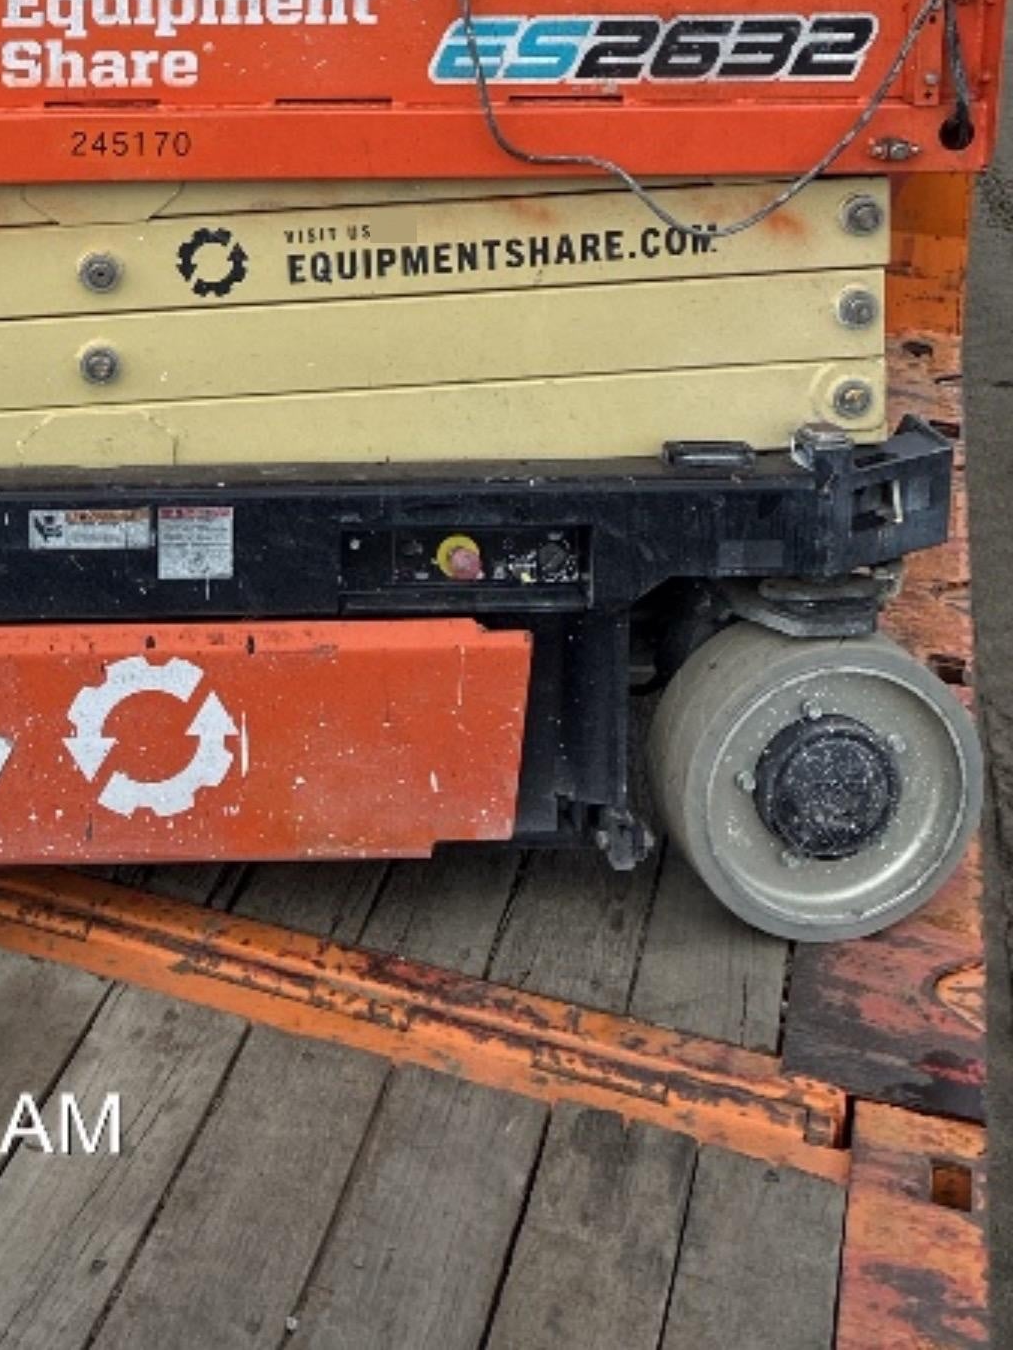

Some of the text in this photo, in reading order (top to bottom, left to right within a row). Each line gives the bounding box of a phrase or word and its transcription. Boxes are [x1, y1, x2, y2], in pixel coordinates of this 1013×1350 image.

[1, 39, 199, 88] Share
[429, 14, 878, 83] ES2632
[70, 131, 192, 157] 245170
[284, 224, 371, 244] VISIT US
[287, 225, 717, 284] EQUIPMENTSHARE.COM
